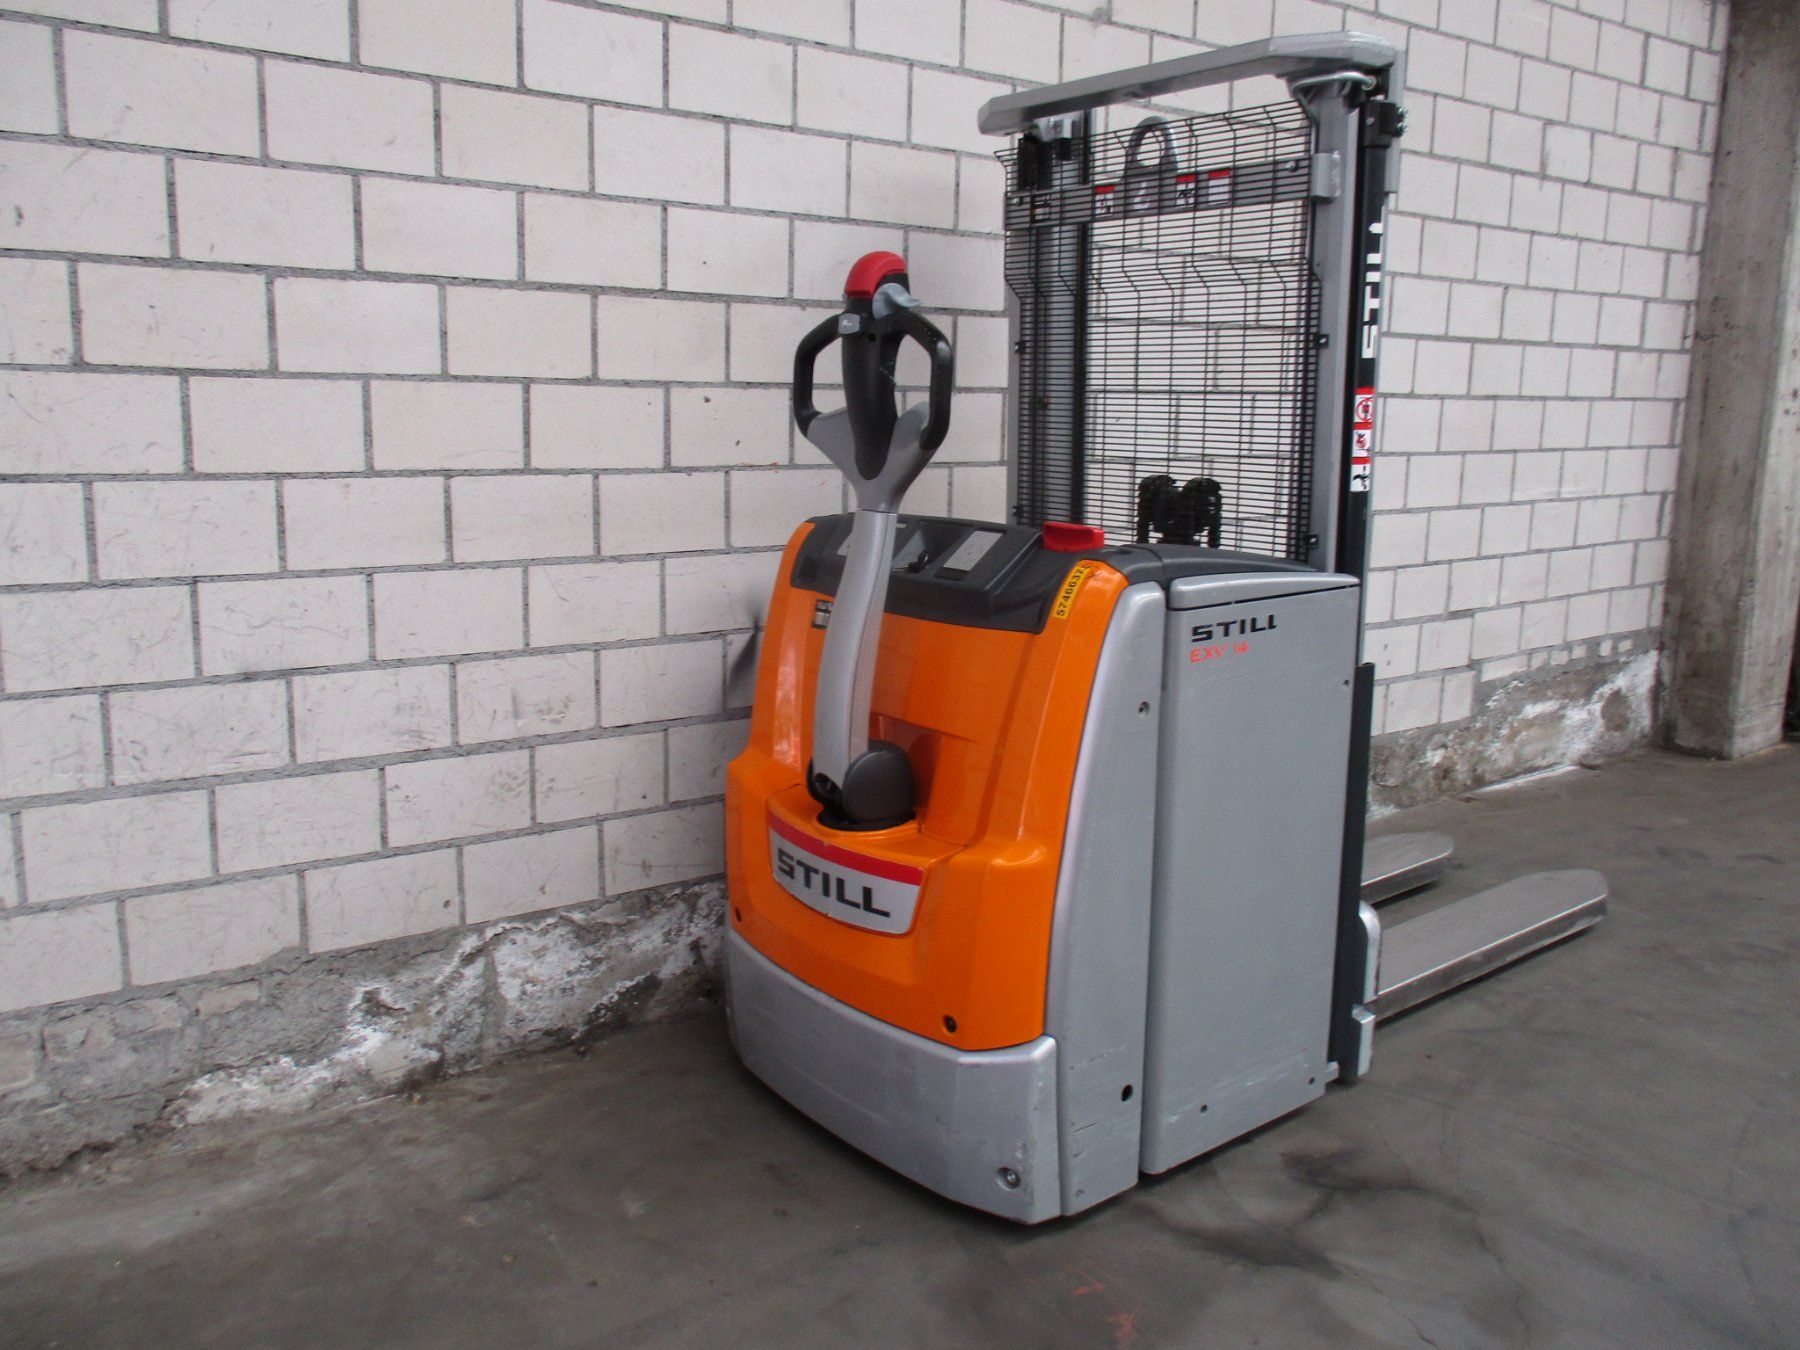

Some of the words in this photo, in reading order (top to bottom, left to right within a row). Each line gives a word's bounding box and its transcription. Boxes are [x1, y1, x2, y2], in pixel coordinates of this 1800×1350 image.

[1362, 205, 1384, 358] STILL
[1191, 614, 1277, 642] STILL
[1190, 643, 1229, 662] EXV
[778, 848, 890, 917] STILL
